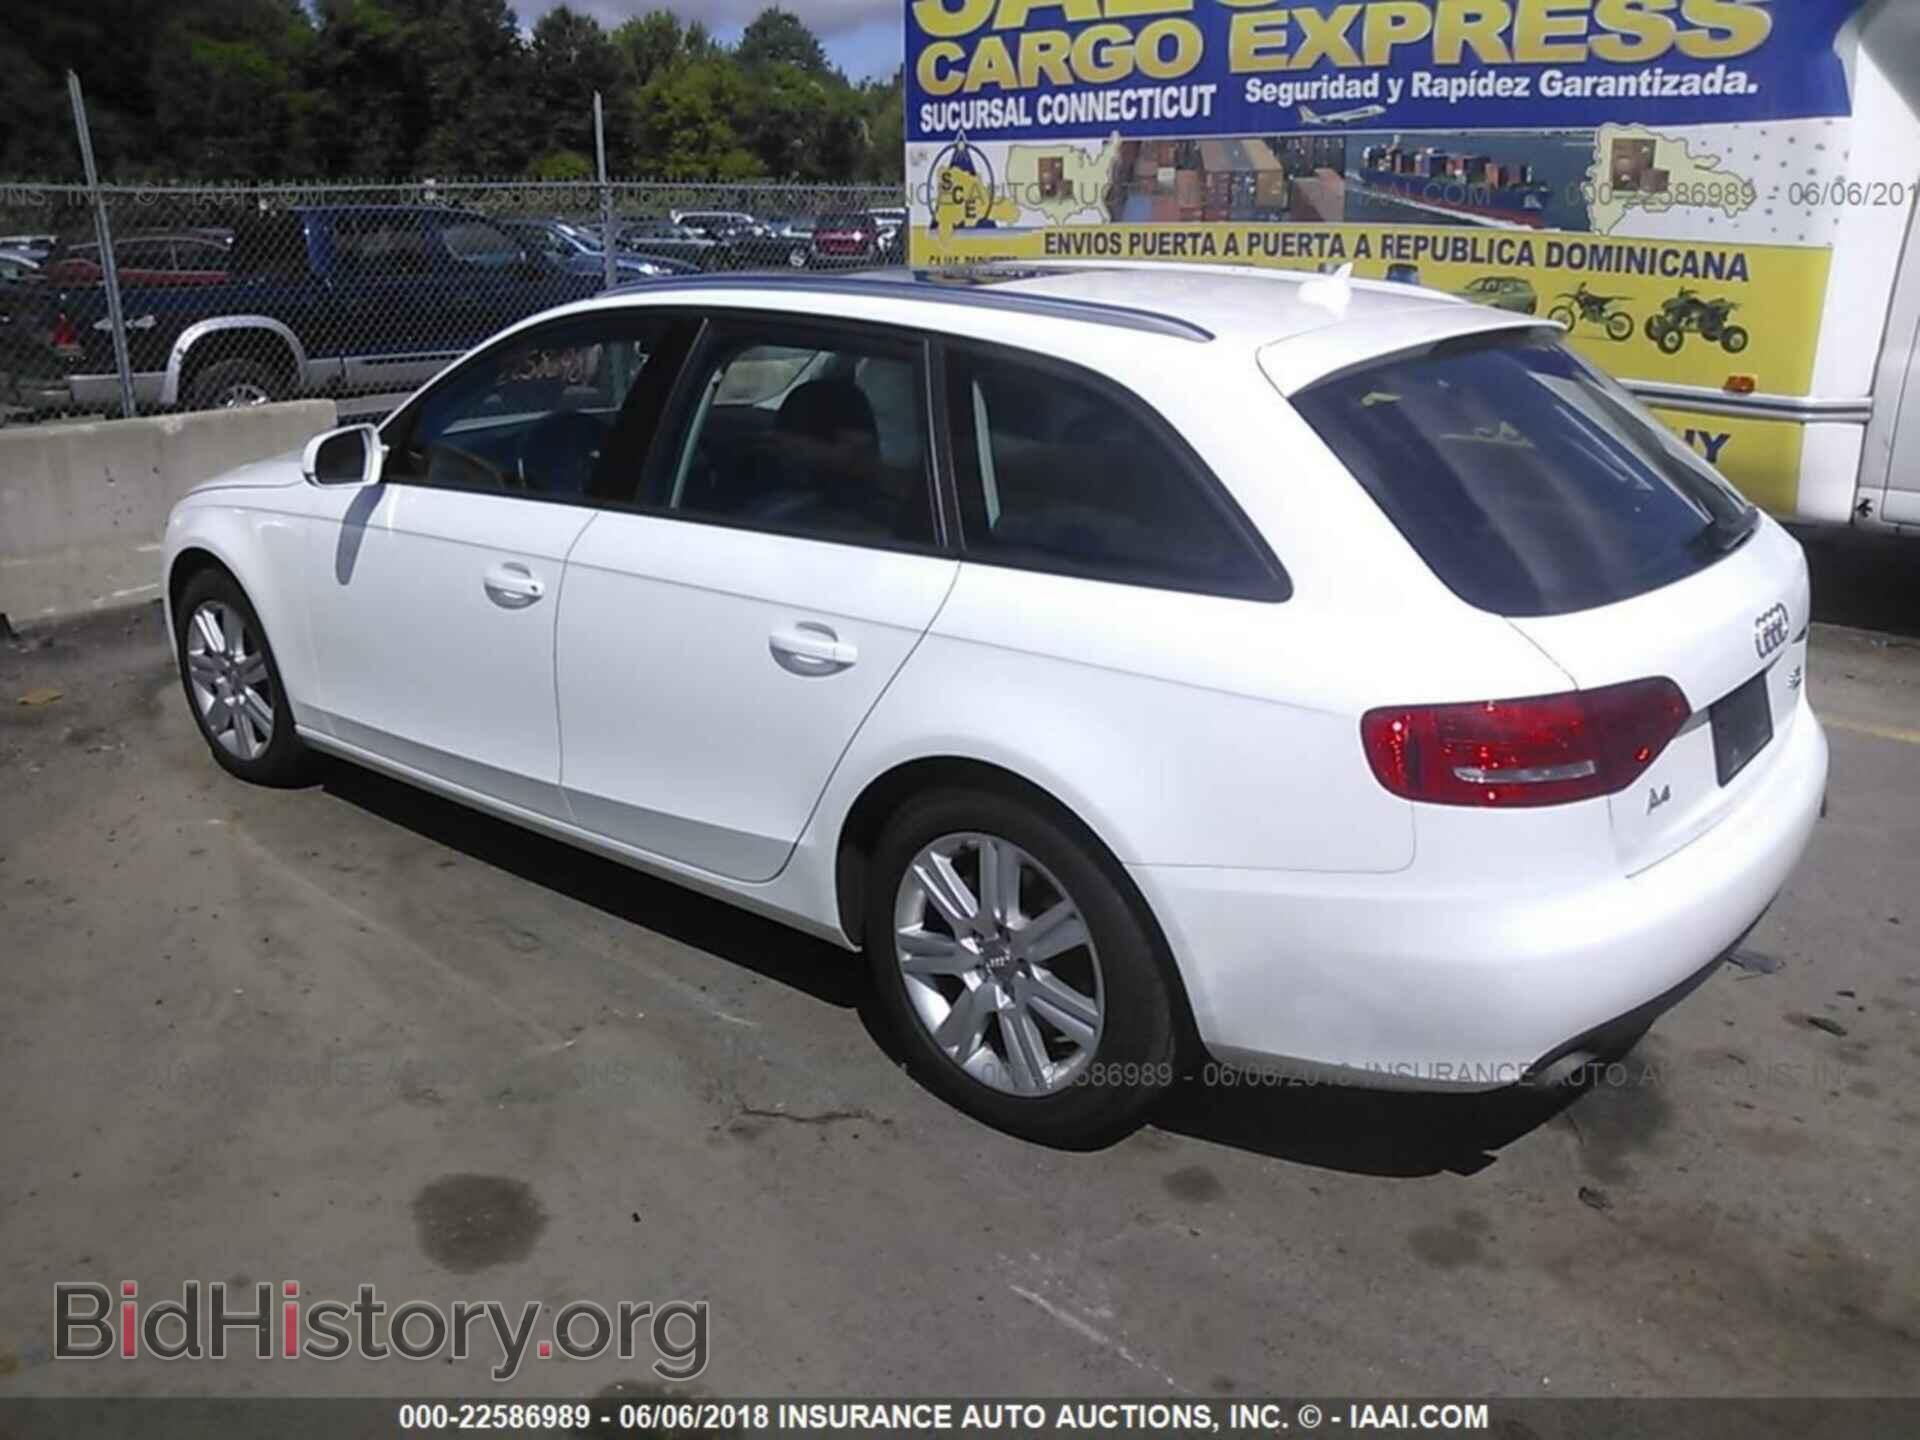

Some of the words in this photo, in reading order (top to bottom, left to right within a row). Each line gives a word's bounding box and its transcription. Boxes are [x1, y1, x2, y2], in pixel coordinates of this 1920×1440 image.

[916, 17, 1203, 96] CARGO
[1228, 0, 1773, 74] EXPRESS
[920, 94, 1031, 133] SUCURSAL
[1037, 86, 1216, 123] CONNECTICUT
[1245, 72, 1380, 107] Seguridad
[1387, 77, 1404, 104] y
[1411, 70, 1530, 104] Rapídez
[1539, 64, 1758, 97] Garantizada.
[1044, 232, 1122, 257] ENVIOS
[1129, 232, 1216, 256] PUERTA
[1223, 233, 1239, 256] A
[1247, 233, 1347, 258] PUERTA
[1354, 235, 1372, 259] A
[1381, 234, 1535, 267] REPUBLICA
[1545, 241, 1750, 281] DOMINICANA
